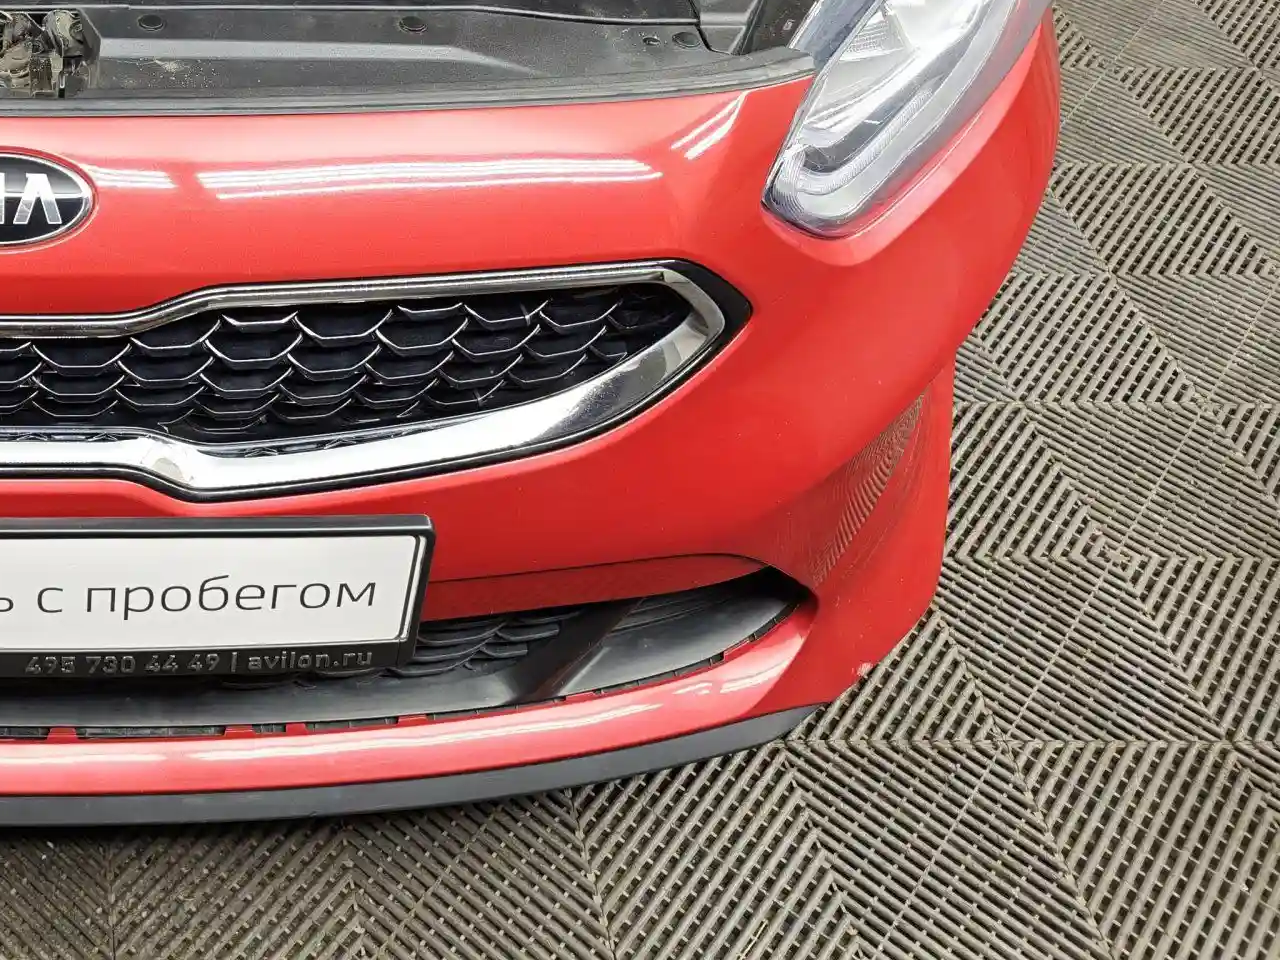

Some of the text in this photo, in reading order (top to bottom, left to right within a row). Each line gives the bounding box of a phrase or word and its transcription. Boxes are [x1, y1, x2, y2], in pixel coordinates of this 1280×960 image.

[37, 587, 63, 613] с
[86, 575, 376, 620] пробегом
[25, 656, 76, 674] 495
[85, 655, 136, 673] 730
[144, 654, 179, 672] 44
[187, 653, 220, 671] 49
[248, 650, 372, 670] avilon.ru
